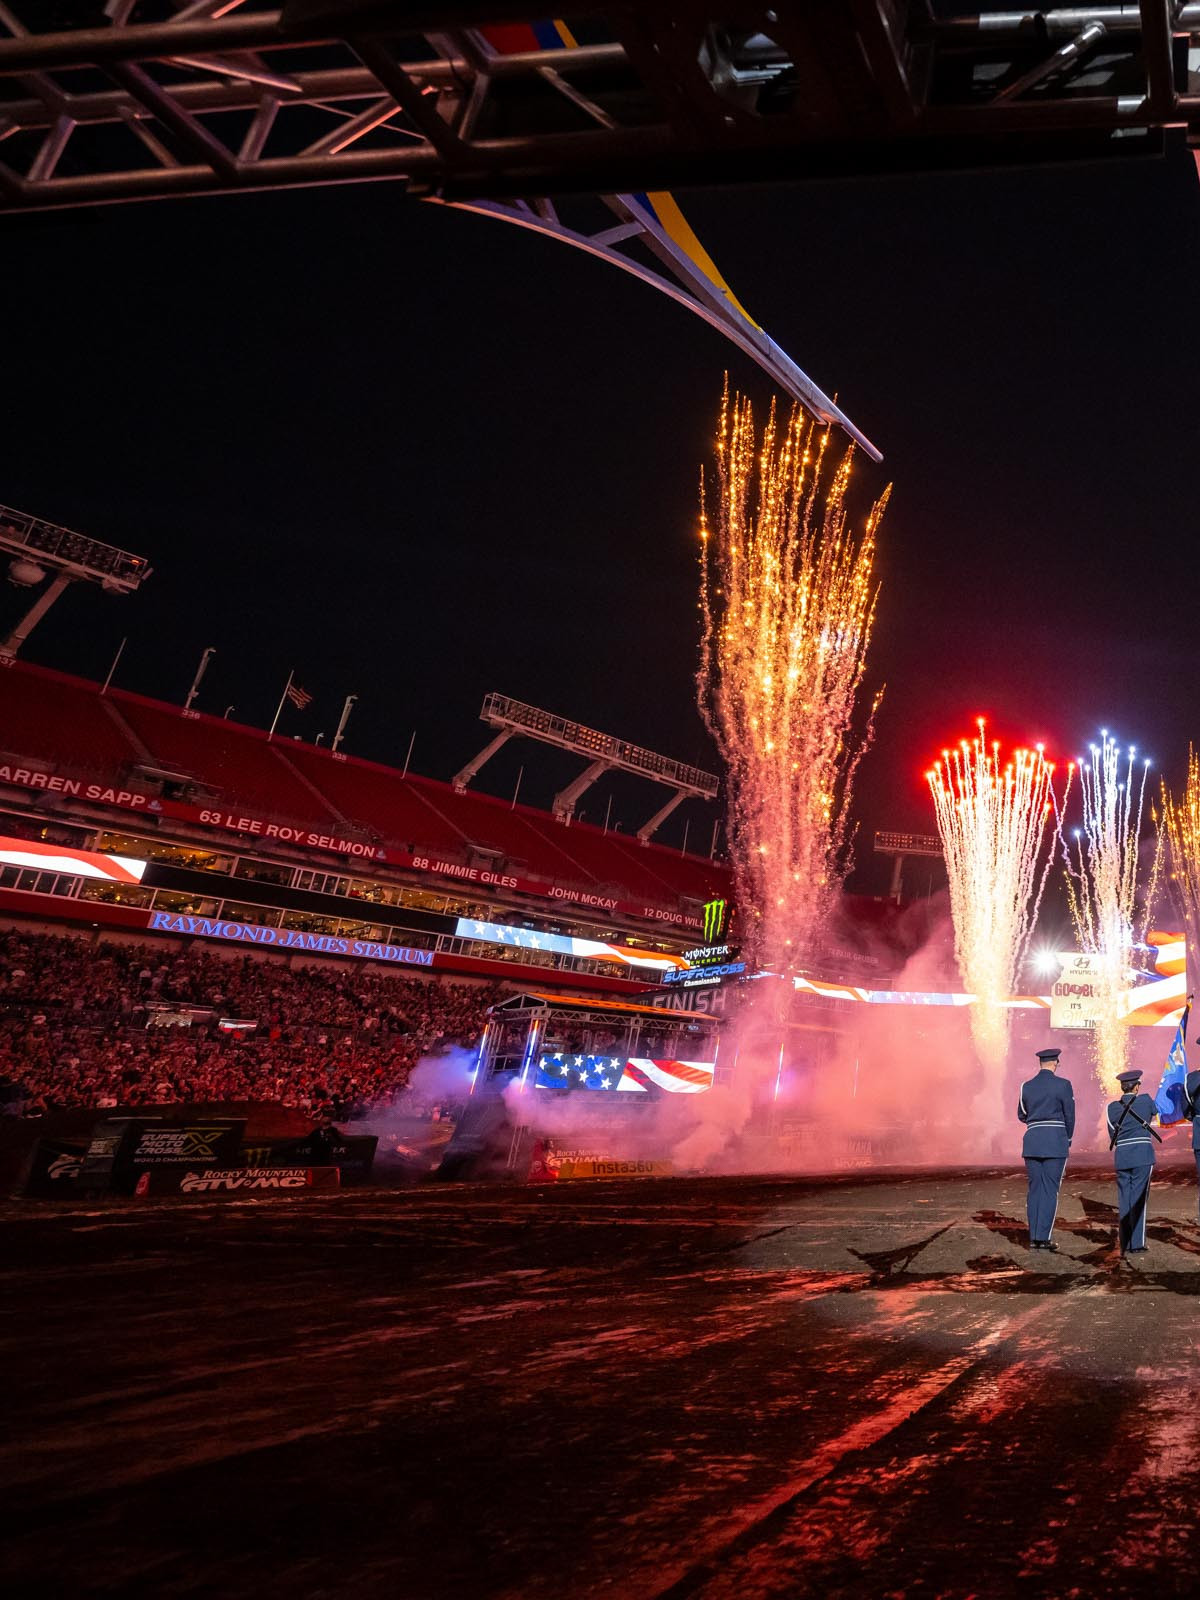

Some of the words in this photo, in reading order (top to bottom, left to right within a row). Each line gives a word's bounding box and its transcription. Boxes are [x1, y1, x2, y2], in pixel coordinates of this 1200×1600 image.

[86, 785, 146, 807] SAPP
[199, 809, 223, 825] 63
[226, 815, 263, 834] LEE
[265, 823, 305, 842] ROY
[307, 833, 376, 858] SELMON
[412, 856, 429, 869] 88
[432, 861, 478, 880] JIMMIE
[480, 871, 518, 888] GILES
[548, 886, 579, 901] JOHN
[580, 894, 618, 909] MCKAY
[643, 908, 655, 917] 12
[656, 910, 683, 923] DOUG
[150, 912, 277, 944] RAYMOND
[279, 930, 349, 953] JAMES
[352, 940, 434, 966] STADIUM
[690, 956, 722, 966] ENERGY
[663, 962, 746, 983] SUPERCROSS
[651, 987, 728, 1013] FINISH
[140, 1133, 189, 1141] SUPER
[140, 1140, 185, 1148] MOTO
[134, 1147, 185, 1155] CROSS
[203, 1170, 244, 1179] ROCKY
[245, 1168, 307, 1178] MOUNTAIN
[592, 1160, 653, 1175] Insta360
